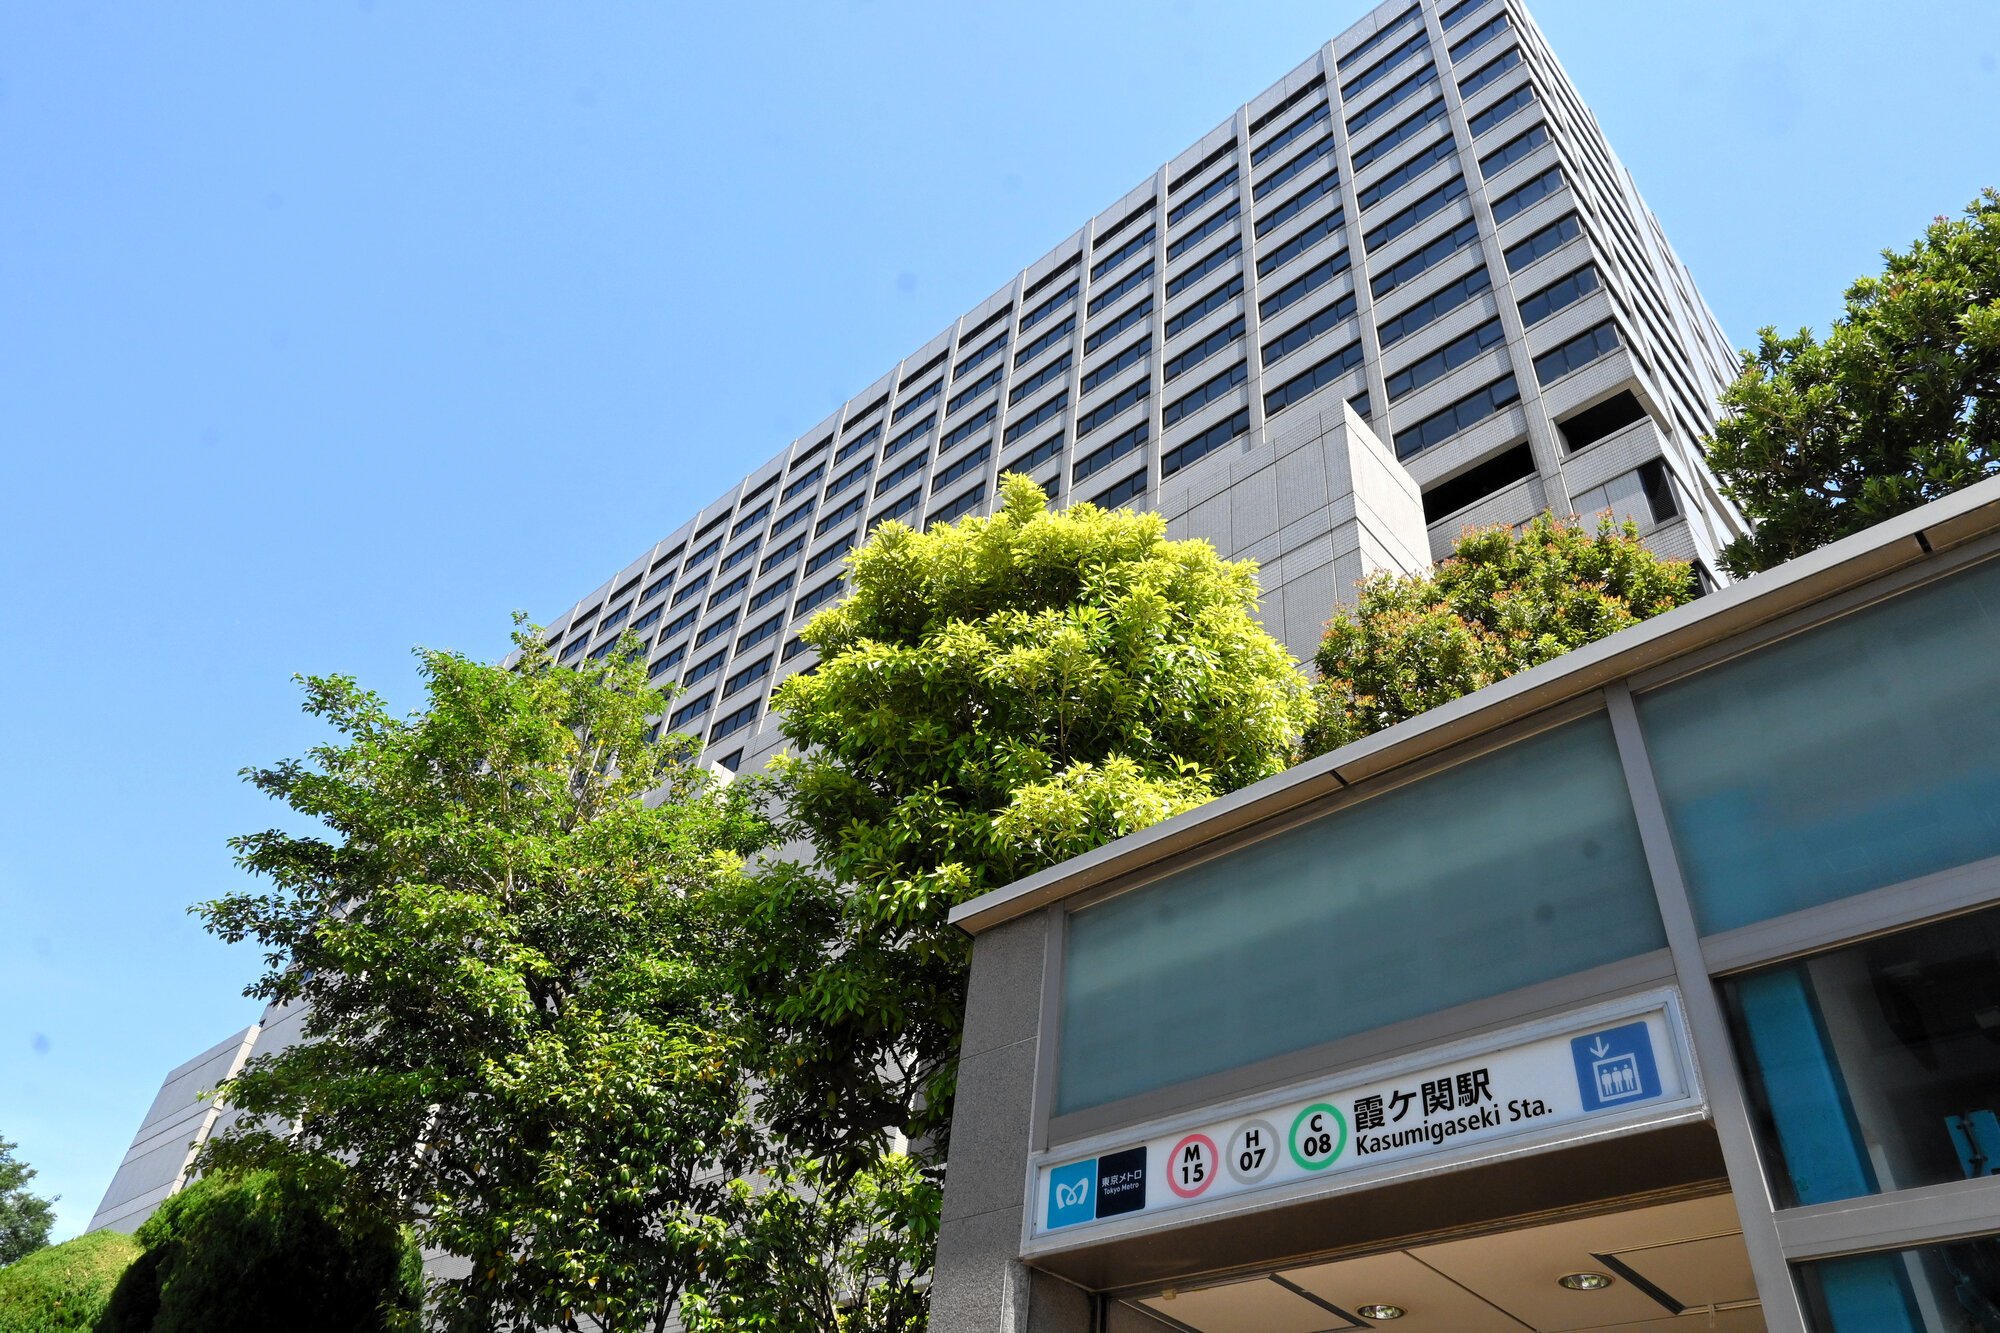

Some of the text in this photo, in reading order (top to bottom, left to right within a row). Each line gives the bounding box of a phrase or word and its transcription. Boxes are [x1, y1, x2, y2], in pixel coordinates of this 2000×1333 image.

[1353, 1067, 1493, 1133] 霞ケ関駅
[1310, 1114, 1323, 1133] C
[1356, 1097, 1553, 1156] Kasumigaseki Sta.
[1245, 1129, 1260, 1149] H
[1303, 1133, 1332, 1157] 08
[1184, 1144, 1201, 1163] M
[1239, 1148, 1266, 1172] 07
[1101, 1169, 1142, 1188] 東京メトロ
[1182, 1163, 1204, 1185] 15
[1103, 1181, 1140, 1195] Tokyo Metro
